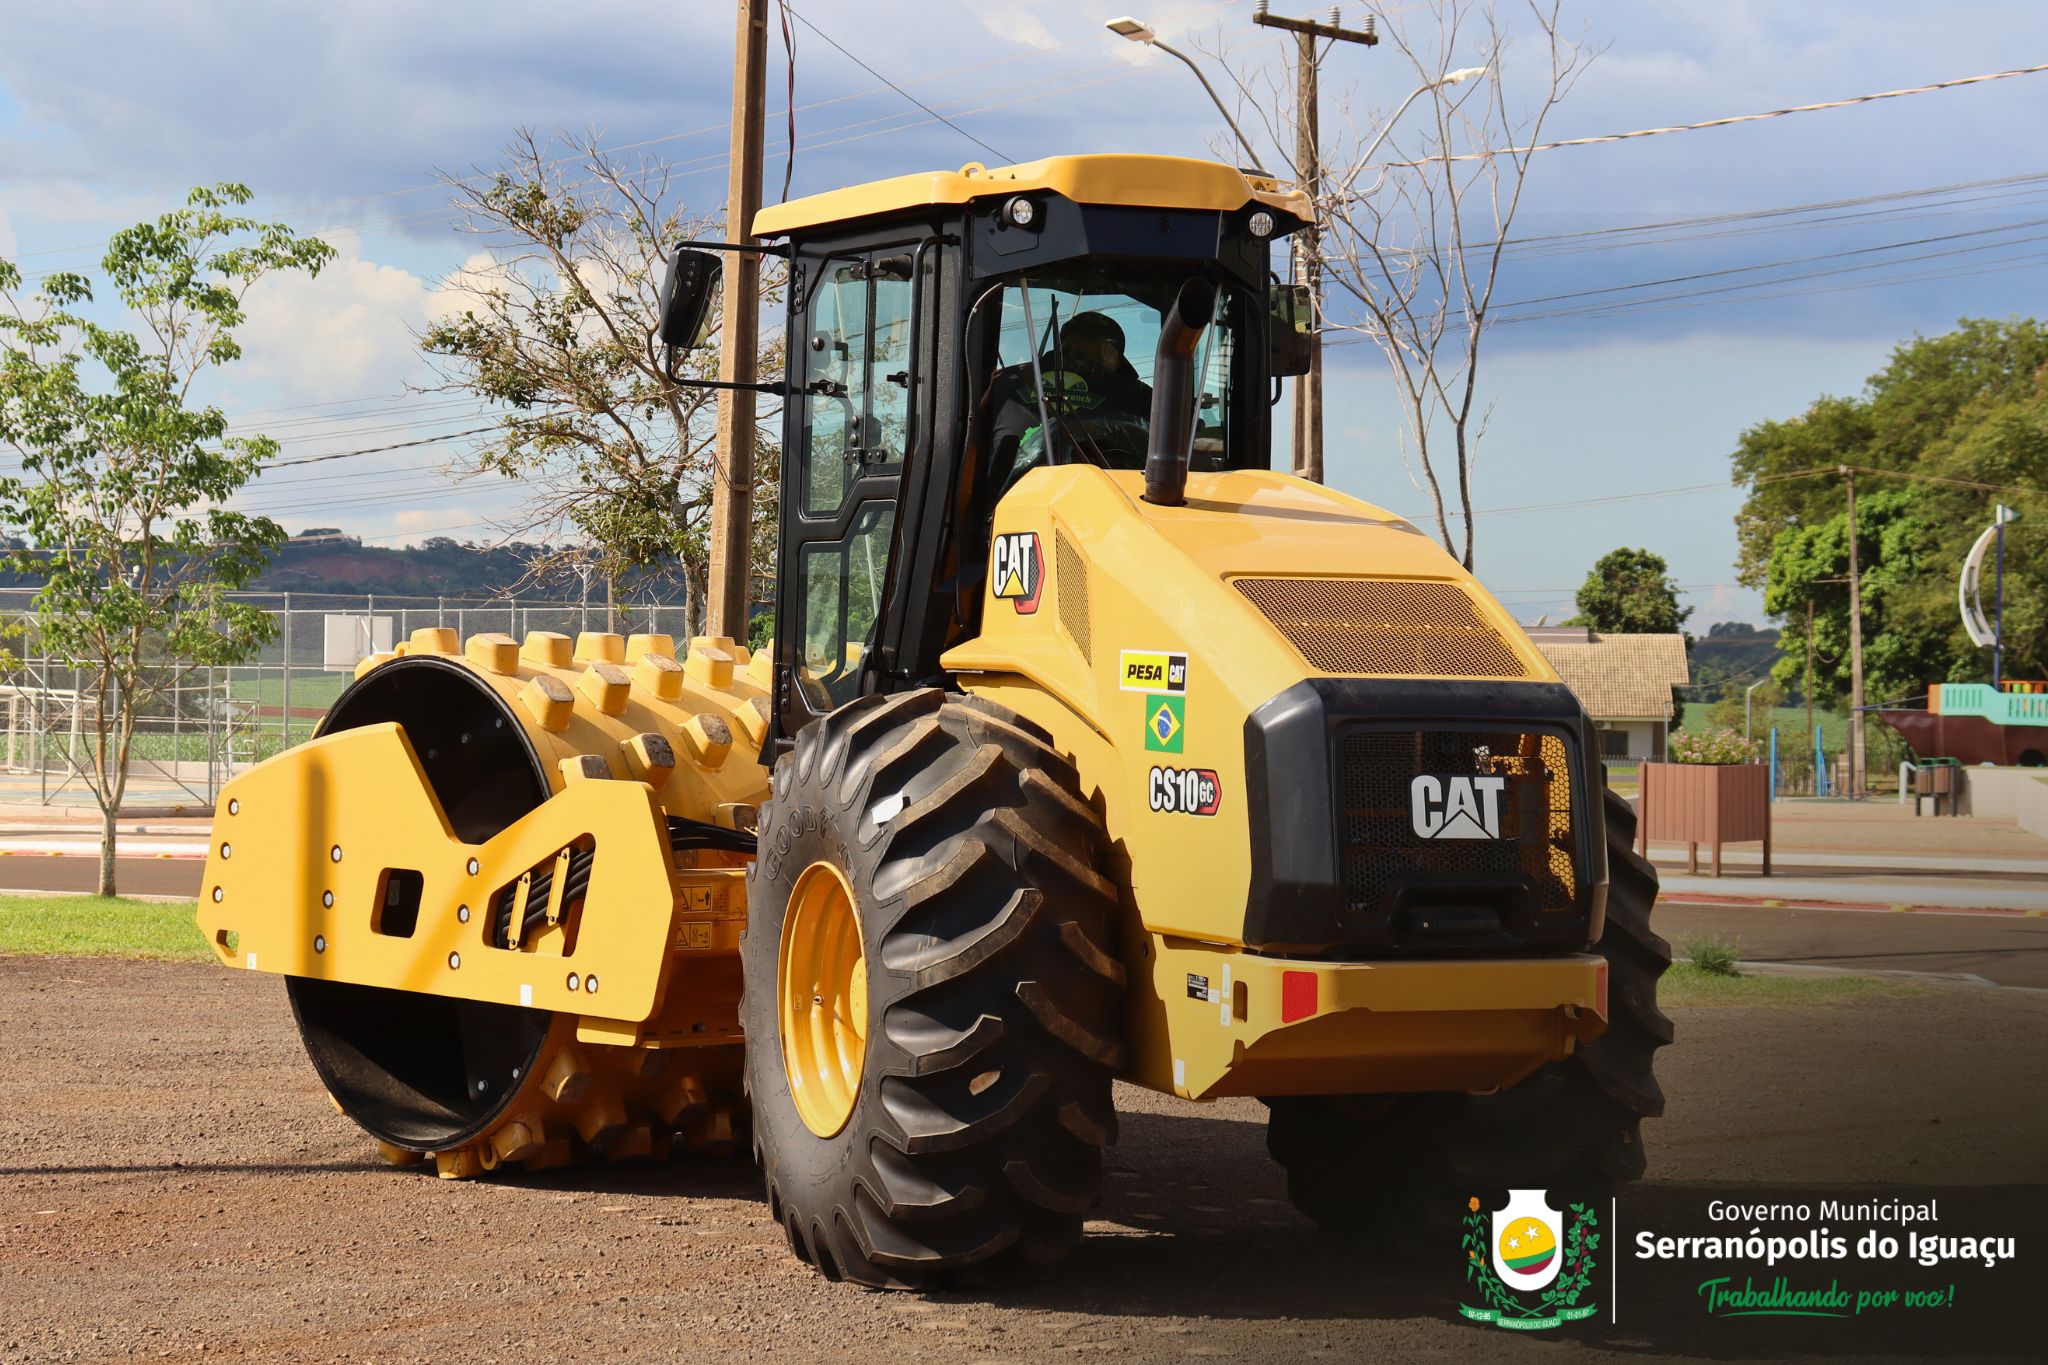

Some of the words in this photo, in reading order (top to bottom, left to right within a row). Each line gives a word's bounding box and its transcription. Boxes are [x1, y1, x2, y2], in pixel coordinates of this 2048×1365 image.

[993, 534, 1034, 597] CAT
[1127, 663, 1162, 681] PESA
[1169, 664, 1186, 684] CAT
[1411, 774, 1504, 839] CAT
